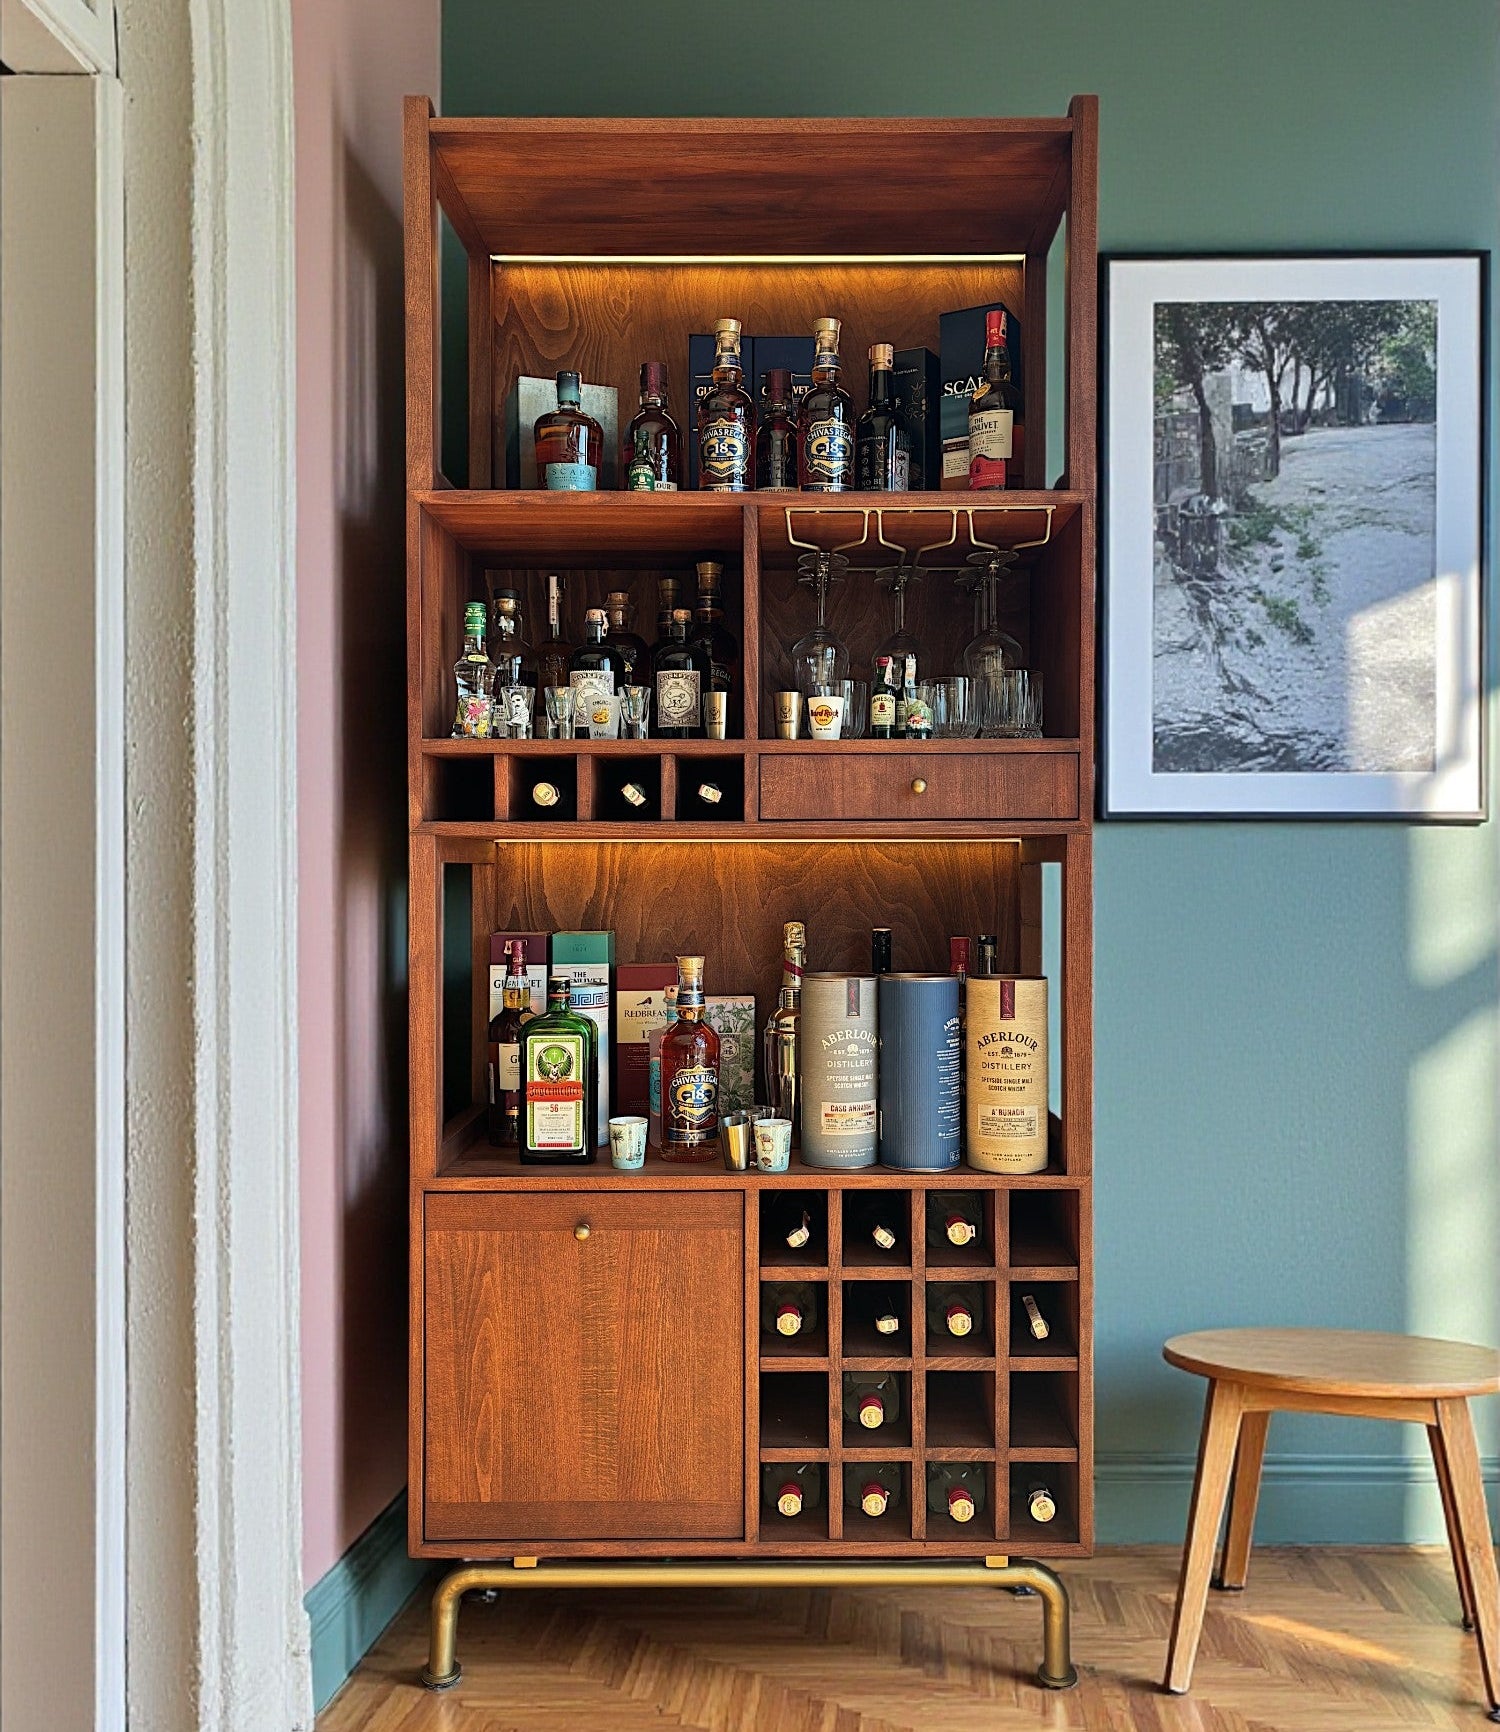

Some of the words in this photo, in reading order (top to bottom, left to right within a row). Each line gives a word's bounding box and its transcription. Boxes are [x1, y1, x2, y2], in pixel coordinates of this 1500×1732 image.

[974, 416, 984, 425] THE
[701, 428, 723, 444] CHIVAS
[724, 429, 747, 444] REGAL
[807, 427, 834, 442] CHIVAS
[714, 442, 728, 454] 18
[825, 442, 839, 453] 18
[552, 468, 592, 478] SCAPA
[624, 1010, 667, 1018] REDBREAS
[821, 1029, 876, 1050] ABERLOUR
[977, 1031, 1038, 1051] ABERLOUR
[827, 1059, 873, 1068] DISTILLERY
[981, 1061, 1032, 1070] DISTILLERY
[672, 1075, 700, 1087] CHIVAS
[701, 1074, 718, 1085] REGAL
[691, 1088, 705, 1100] 18
[549, 1103, 559, 1113] 56
